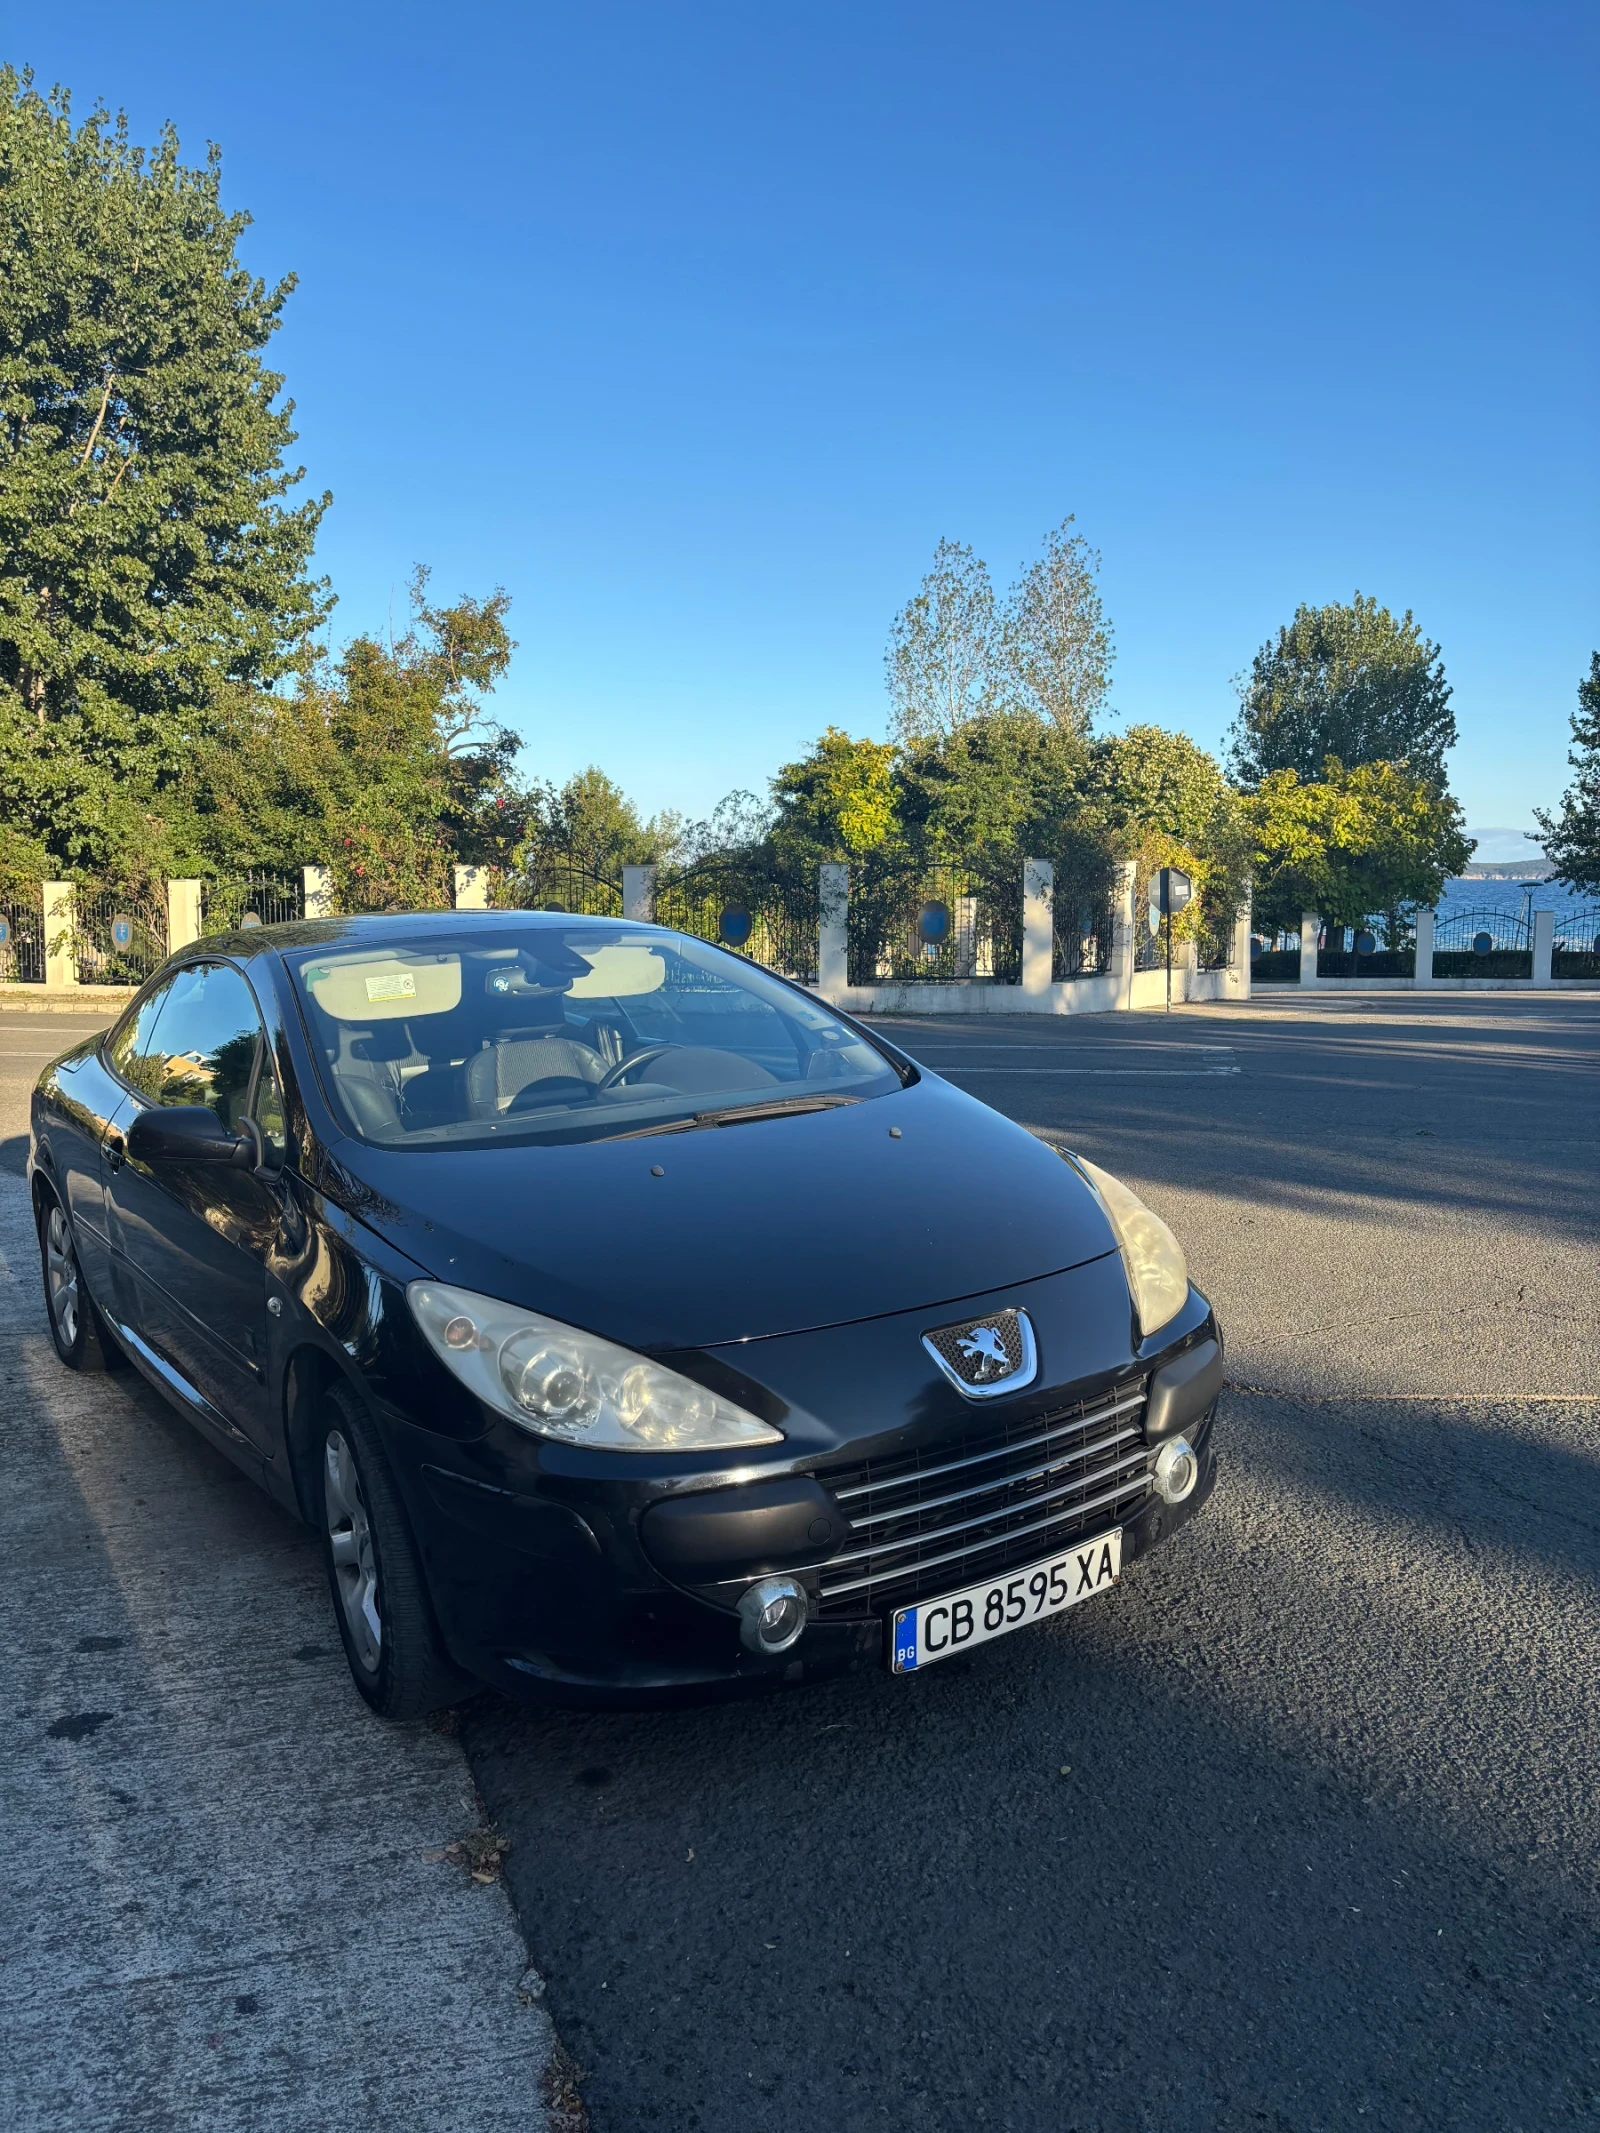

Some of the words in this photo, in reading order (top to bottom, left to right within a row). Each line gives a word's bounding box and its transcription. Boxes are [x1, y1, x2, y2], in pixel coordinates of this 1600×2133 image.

[924, 1599, 974, 1652] CB
[984, 1561, 1068, 1631] 8595
[1075, 1542, 1113, 1596] XA
[897, 1645, 915, 1661] BG
